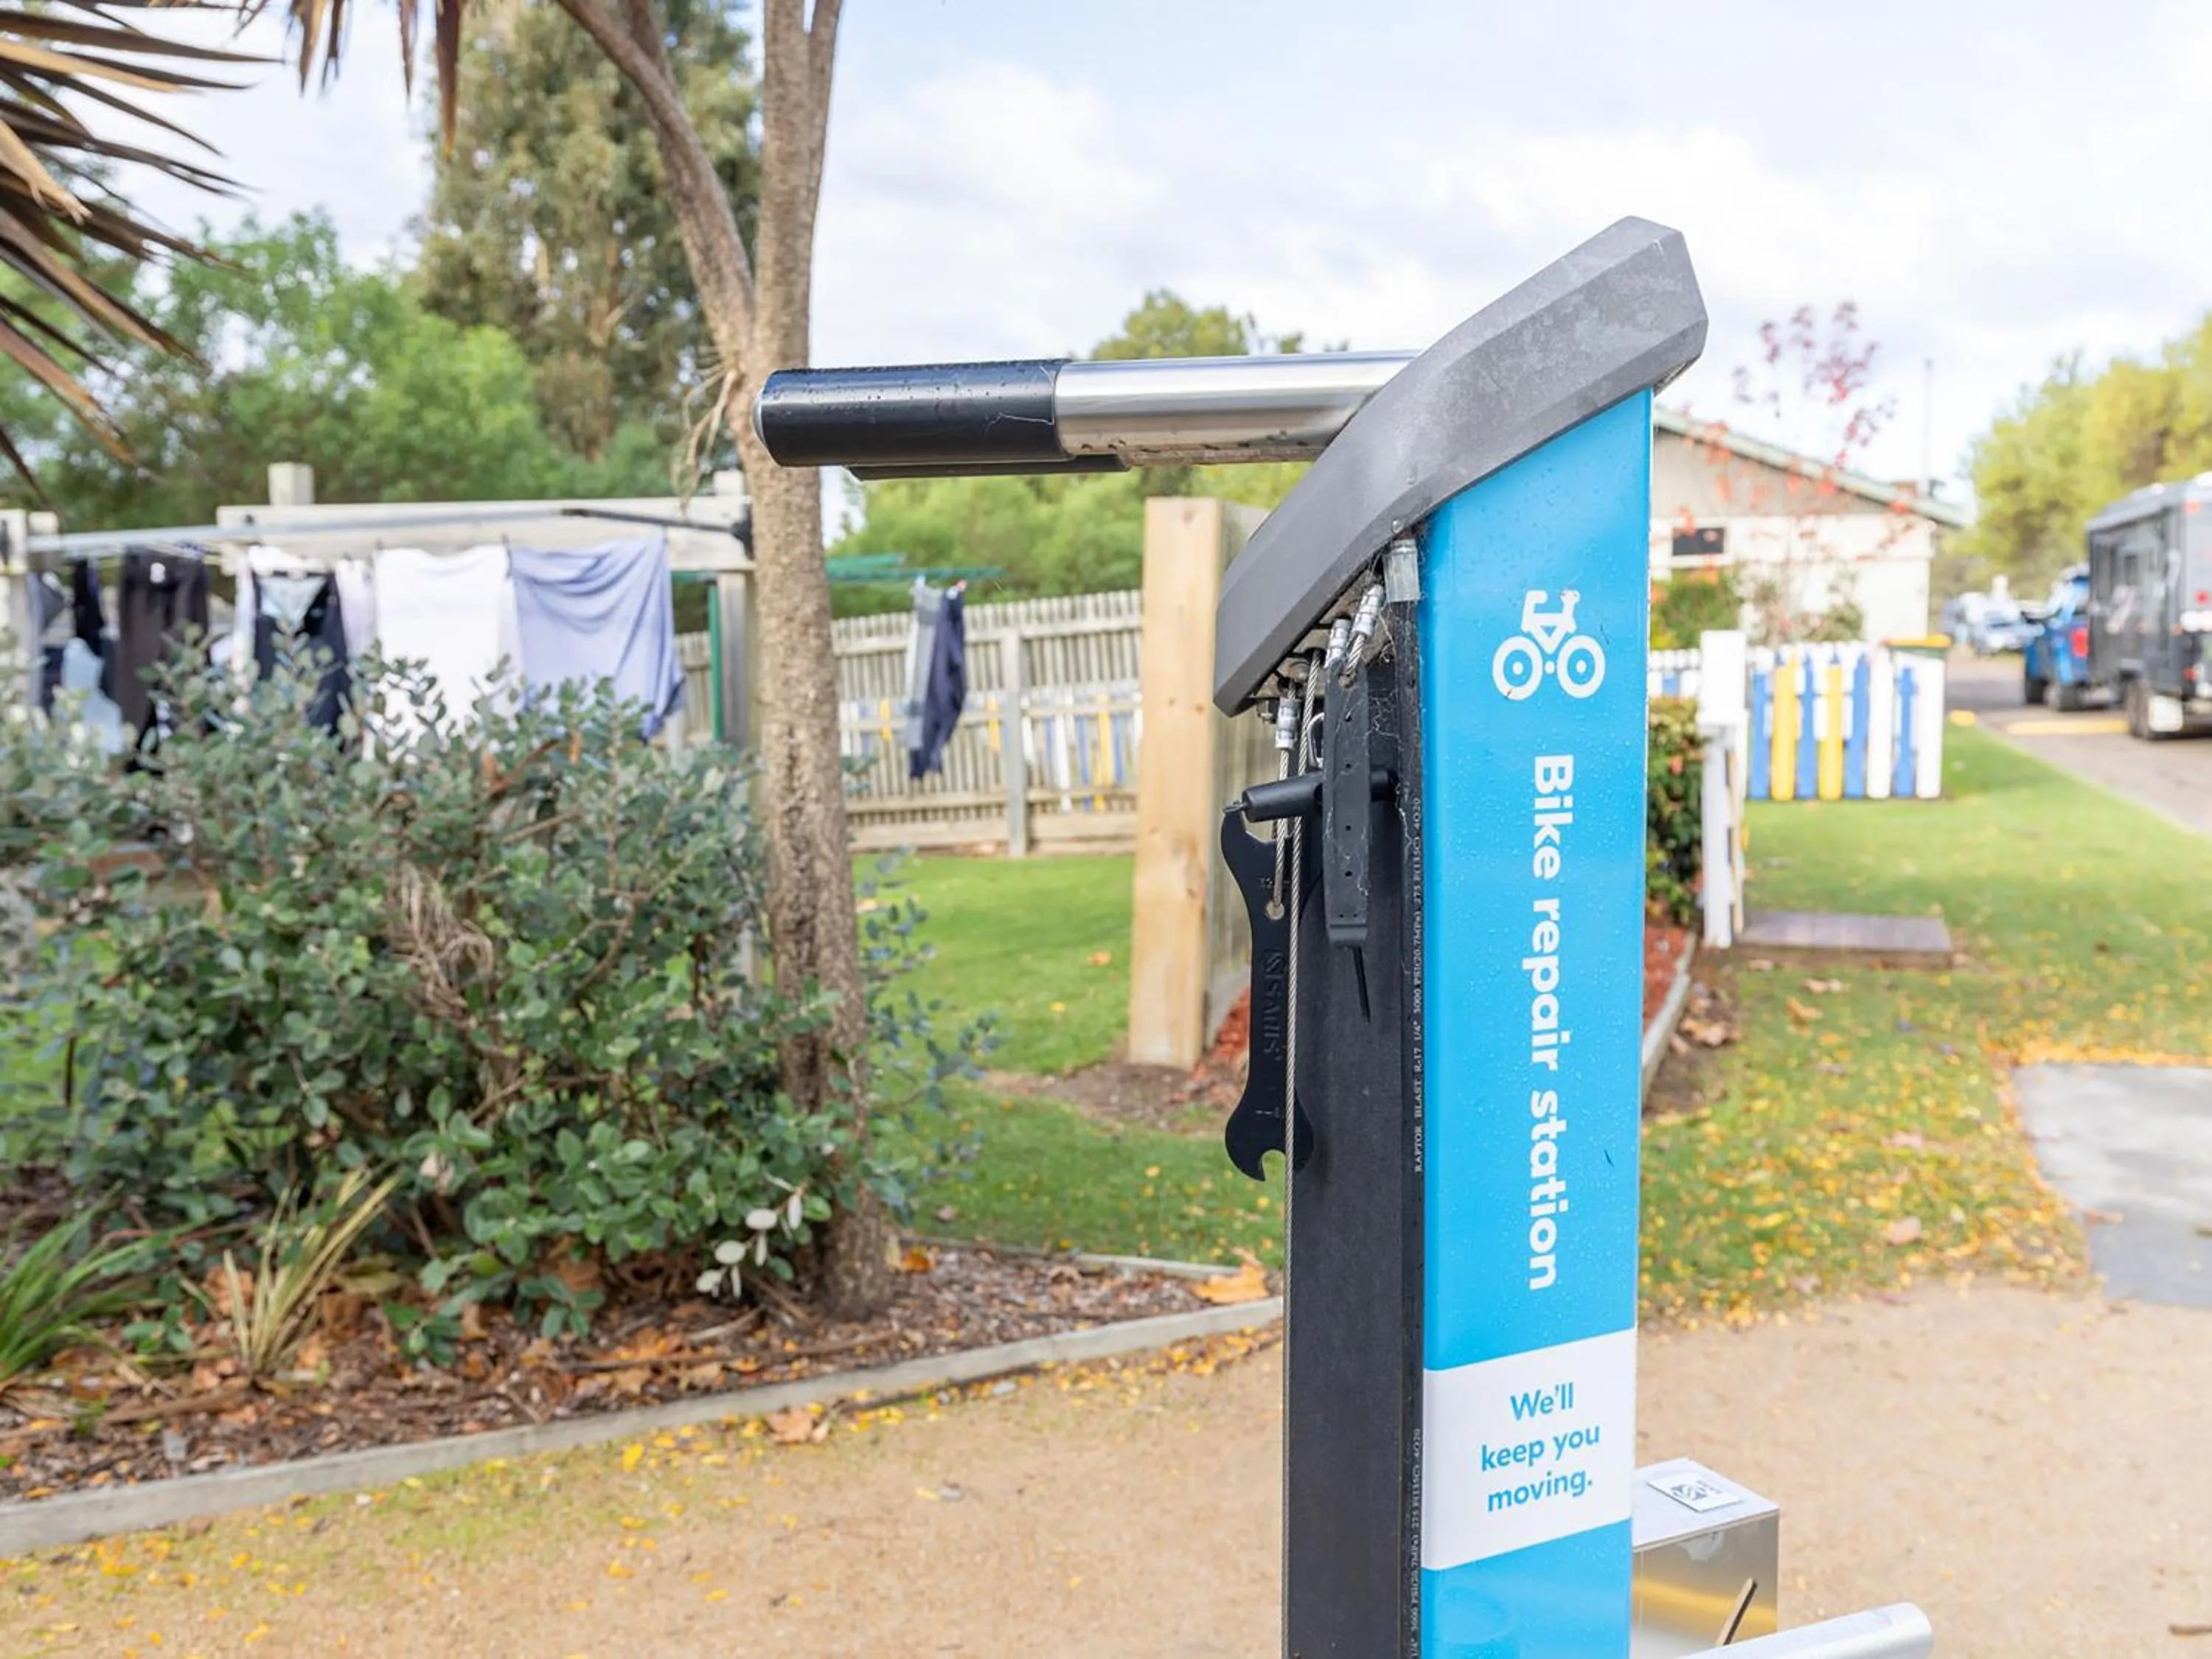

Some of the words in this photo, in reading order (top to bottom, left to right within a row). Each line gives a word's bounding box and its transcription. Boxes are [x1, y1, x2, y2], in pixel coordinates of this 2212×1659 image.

[1532, 755, 1573, 880] Bike
[1413, 884, 1422, 905] 275
[1413, 988, 1423, 1015] 3000
[1521, 898, 1571, 1071] repair
[1413, 1020, 1423, 1041] 1/4"
[1413, 1047, 1423, 1073] R-17
[1413, 1078, 1423, 1119] BLAST
[1413, 1125, 1423, 1173] RAPTOR
[1529, 1090, 1569, 1291] station
[1510, 1382, 1574, 1421] We'll
[1481, 1439, 1545, 1471] keep
[1552, 1426, 1600, 1461] you
[1487, 1470, 1593, 1512] moving.
